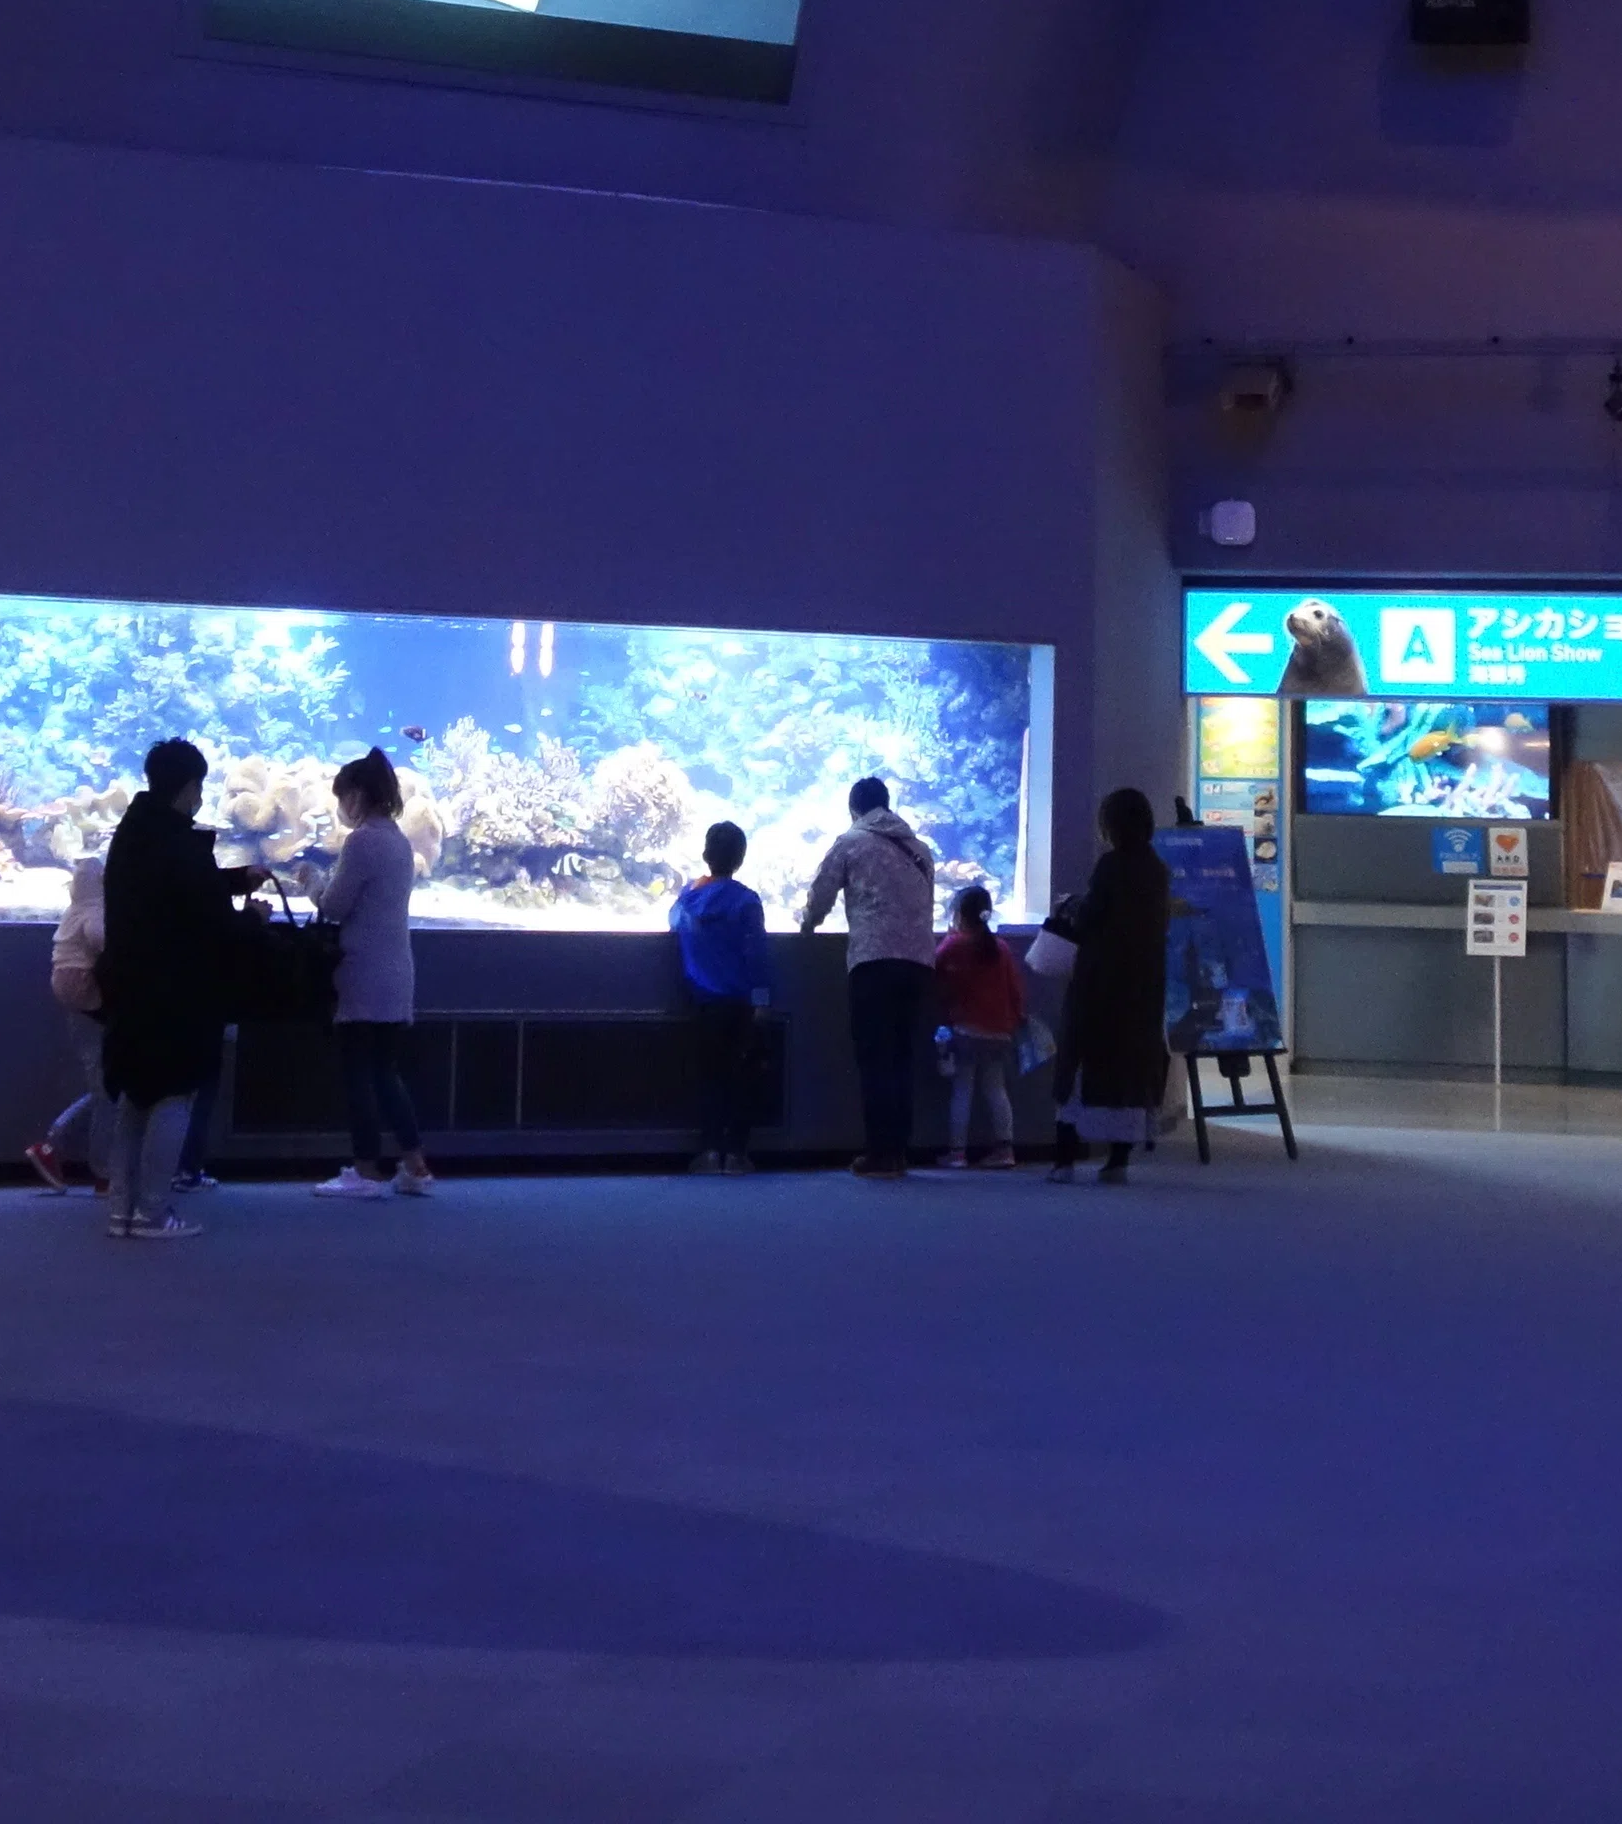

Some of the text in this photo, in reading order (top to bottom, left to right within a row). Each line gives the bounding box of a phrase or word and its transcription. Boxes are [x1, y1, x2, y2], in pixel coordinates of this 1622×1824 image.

[1401, 625, 1434, 665] A
[1506, 641, 1548, 662] Lion
[1550, 641, 1604, 663] Show
